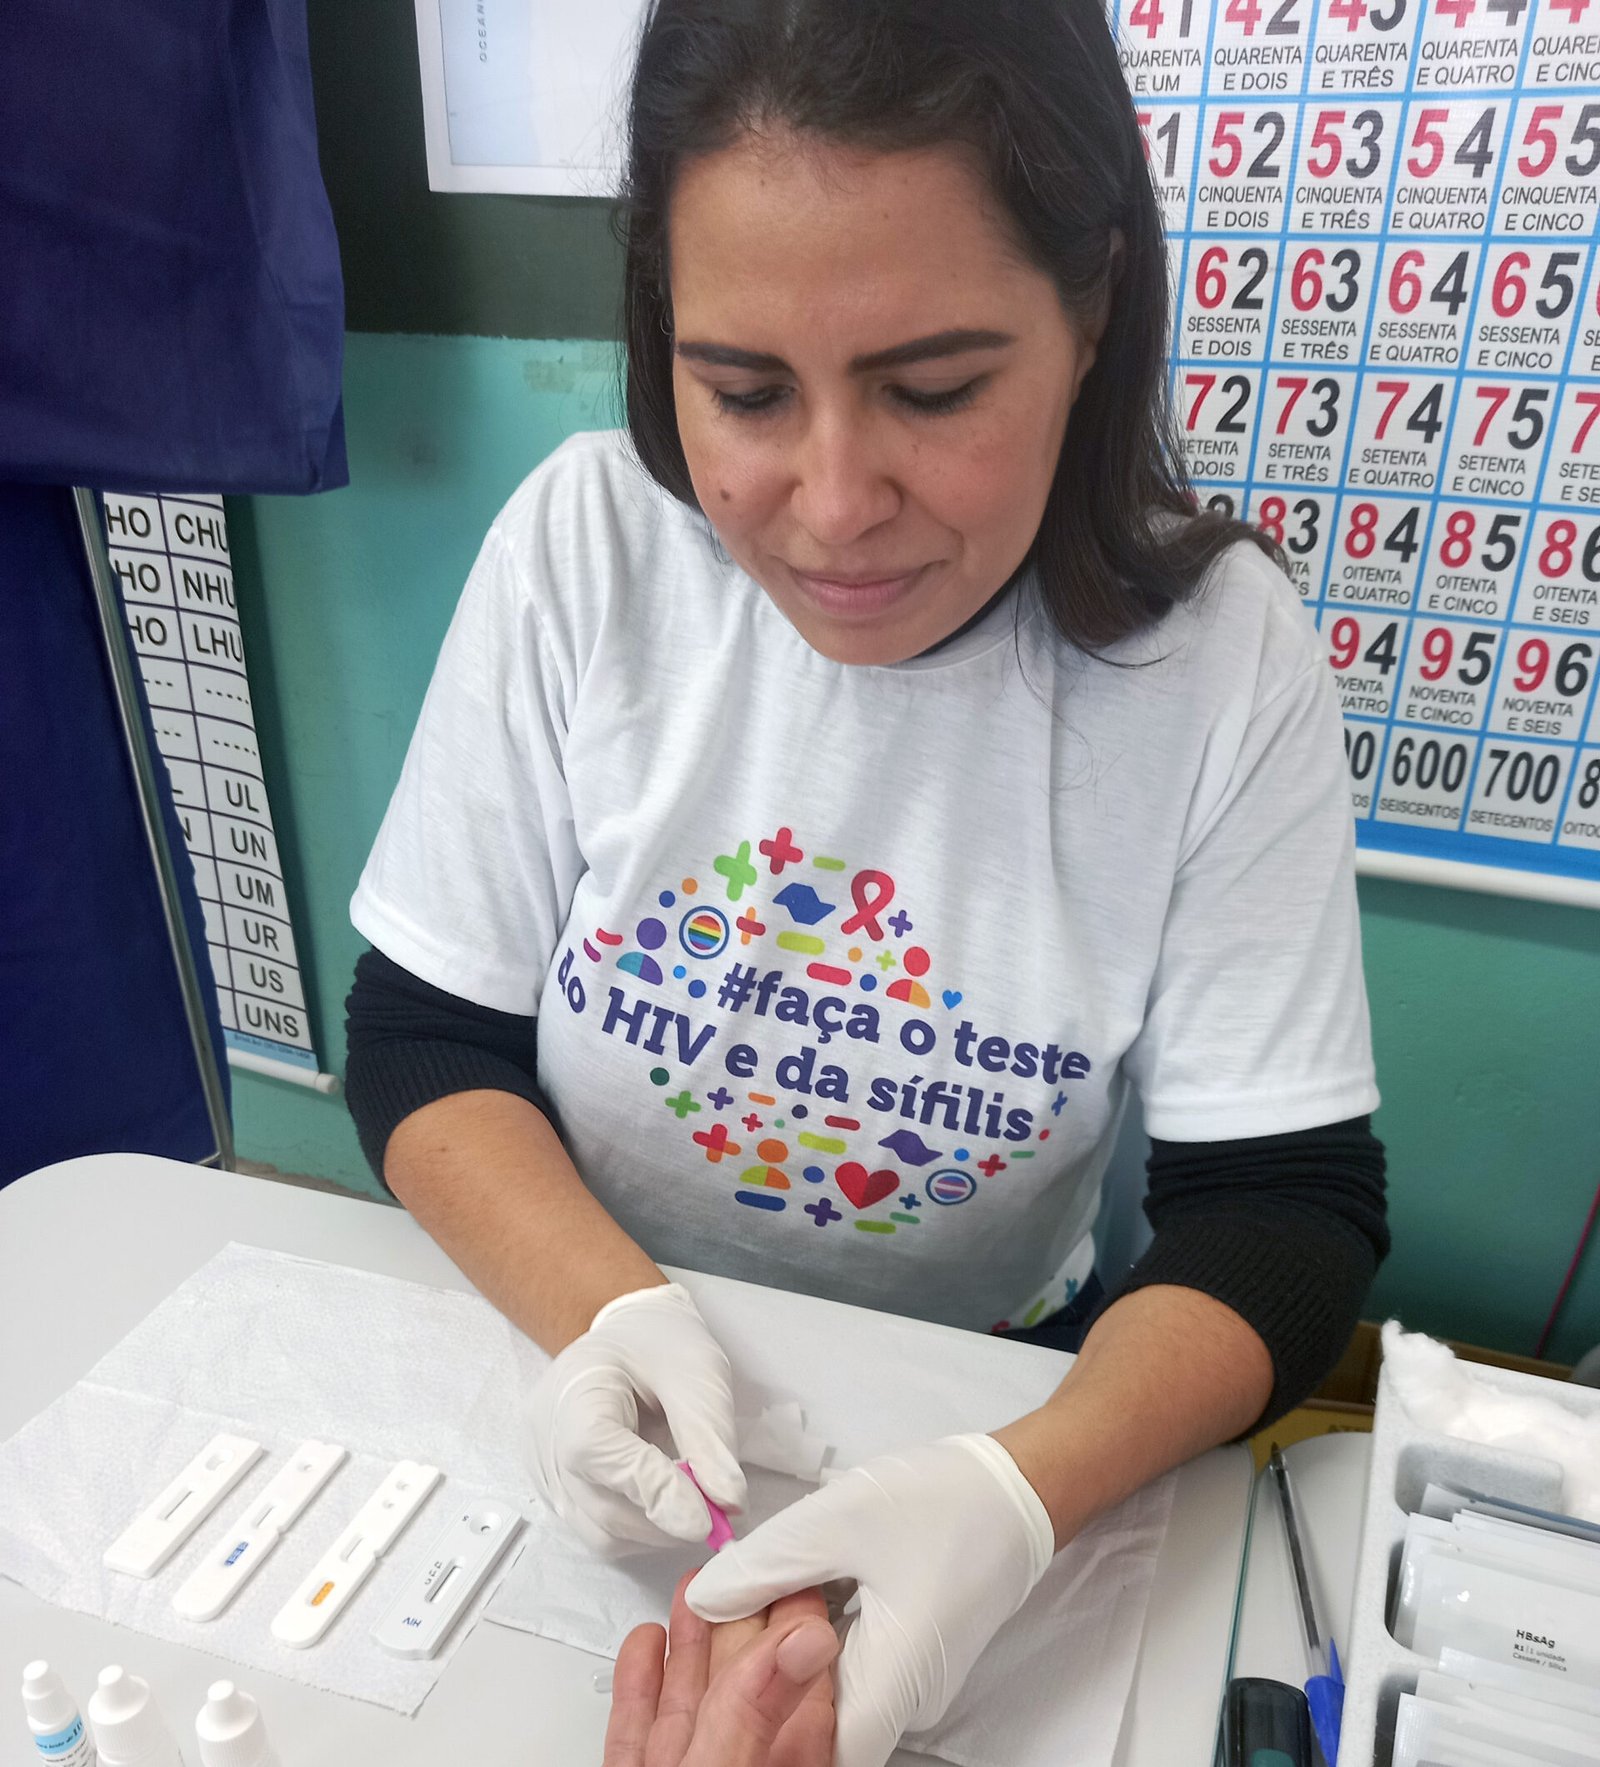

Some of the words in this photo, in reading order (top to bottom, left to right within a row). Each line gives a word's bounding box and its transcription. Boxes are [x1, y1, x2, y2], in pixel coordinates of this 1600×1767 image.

[476, 0, 488, 63] OCEAN
[1213, 46, 1302, 66] QUARENTA
[1315, 42, 1408, 64] QUARENTA
[1421, 38, 1518, 61] QUARENTA
[1532, 35, 1600, 56] QUARE
[1119, 48, 1202, 68] QUARENTA
[1223, 73, 1236, 90] E
[1241, 72, 1288, 90] DOIS
[1321, 70, 1335, 88] E
[1341, 65, 1394, 88] TRÊS
[1416, 67, 1431, 85] E
[1434, 64, 1515, 85] QUATRO
[1536, 63, 1550, 82] E
[1555, 61, 1600, 81] CINC
[1135, 75, 1147, 92] E
[1152, 74, 1181, 92] UM
[1136, 112, 1180, 178] 1
[1208, 111, 1286, 178] 52
[1307, 110, 1384, 178] 53
[1407, 107, 1497, 178] 54
[1517, 104, 1600, 178] 55
[1198, 186, 1283, 204] CINQUENTA
[1295, 187, 1383, 205] CINQUENTA
[1396, 187, 1488, 205] CINQUENTA
[1502, 187, 1598, 206] CINQUENTA
[1207, 211, 1218, 228] E
[1223, 211, 1269, 229] DOIS
[1302, 212, 1313, 229] E
[1319, 209, 1370, 230] TRÊS
[1392, 212, 1404, 229] E
[1408, 211, 1485, 231] QUATRO
[1505, 213, 1517, 230] E
[1522, 213, 1584, 231] CINCO
[1195, 246, 1269, 310] 62
[1290, 248, 1361, 313] 63
[1388, 250, 1469, 315] 64
[1491, 251, 1580, 319] 65
[1187, 316, 1261, 334] SESSENTA
[1281, 318, 1357, 337] SESSENTA
[1378, 322, 1457, 341] SESSENTA
[1478, 325, 1561, 346] SESSENTA
[1192, 339, 1202, 355] E
[1207, 340, 1252, 357] DOIS
[1283, 343, 1295, 358] E
[1302, 340, 1349, 360] TRÊS
[1369, 345, 1381, 362] E
[1386, 345, 1459, 364] QUATRO
[1477, 350, 1490, 366] E
[1494, 352, 1553, 370] CINCO
[1184, 373, 1252, 433] 72
[1275, 376, 1341, 438] 73
[1374, 380, 1445, 444] 74
[1473, 385, 1550, 450] 75
[1570, 391, 1600, 454] 7
[1268, 443, 1331, 461] SETENTA
[1361, 448, 1427, 467] SETENTA
[1193, 460, 1235, 477] DOIS
[1265, 464, 1277, 480] E
[1284, 463, 1329, 482] TRÊS
[1457, 454, 1526, 475] SETENTA
[1559, 462, 1600, 480] SETE
[1348, 469, 1361, 484] E
[1364, 469, 1435, 489] QUATRO
[1452, 476, 1465, 492] E
[1470, 478, 1525, 497] CINCO
[1561, 485, 1573, 501] E
[1578, 486, 1600, 503] SE
[105, 503, 151, 538] HO
[1259, 496, 1320, 555] 83
[1344, 503, 1420, 563] 84
[1439, 510, 1521, 572] 85
[115, 560, 161, 593] HO
[1342, 566, 1402, 584] OITENTA
[1435, 575, 1497, 595] OITENTA
[1328, 584, 1340, 598] E
[1343, 586, 1411, 605] QUATRO
[1428, 594, 1441, 609] E
[1445, 596, 1498, 616] CINCO
[1533, 585, 1598, 604] OITENTA
[1533, 606, 1545, 621] E
[1550, 608, 1590, 626] SEIS
[129, 615, 167, 646] HO
[193, 624, 244, 663] LHU
[1329, 617, 1398, 675] 94
[1419, 627, 1496, 686] 95
[1513, 638, 1593, 697] 96
[1335, 675, 1384, 694] VENTA
[1341, 694, 1389, 714] ATRO
[1409, 686, 1476, 706] NOVENTA
[1405, 705, 1417, 719] E
[1420, 706, 1473, 726] CINCO
[1503, 697, 1573, 717] NOVENTA
[1507, 717, 1518, 731] E
[1523, 719, 1562, 735] SEIS
[1392, 737, 1468, 793] 600
[1484, 749, 1561, 804] 700
[225, 779, 260, 813] UL
[1379, 797, 1461, 820] SEISCENTOS
[1469, 809, 1554, 832] SETECENTOS
[230, 827, 268, 862] UN
[235, 873, 275, 908] UM
[243, 918, 279, 952] UR
[249, 963, 284, 994] US
[244, 1003, 299, 1038] UNS
[717, 963, 880, 1044] #faça
[900, 1019, 936, 1056] o
[954, 1021, 1091, 1085] teste
[558, 947, 586, 1014] do
[602, 986, 716, 1067] HIV
[725, 1043, 758, 1078] e
[775, 1047, 849, 1103] da
[867, 1075, 1034, 1142] sífilis
[402, 1616, 422, 1628] HIV
[1516, 1629, 1555, 1649] HBsAg
